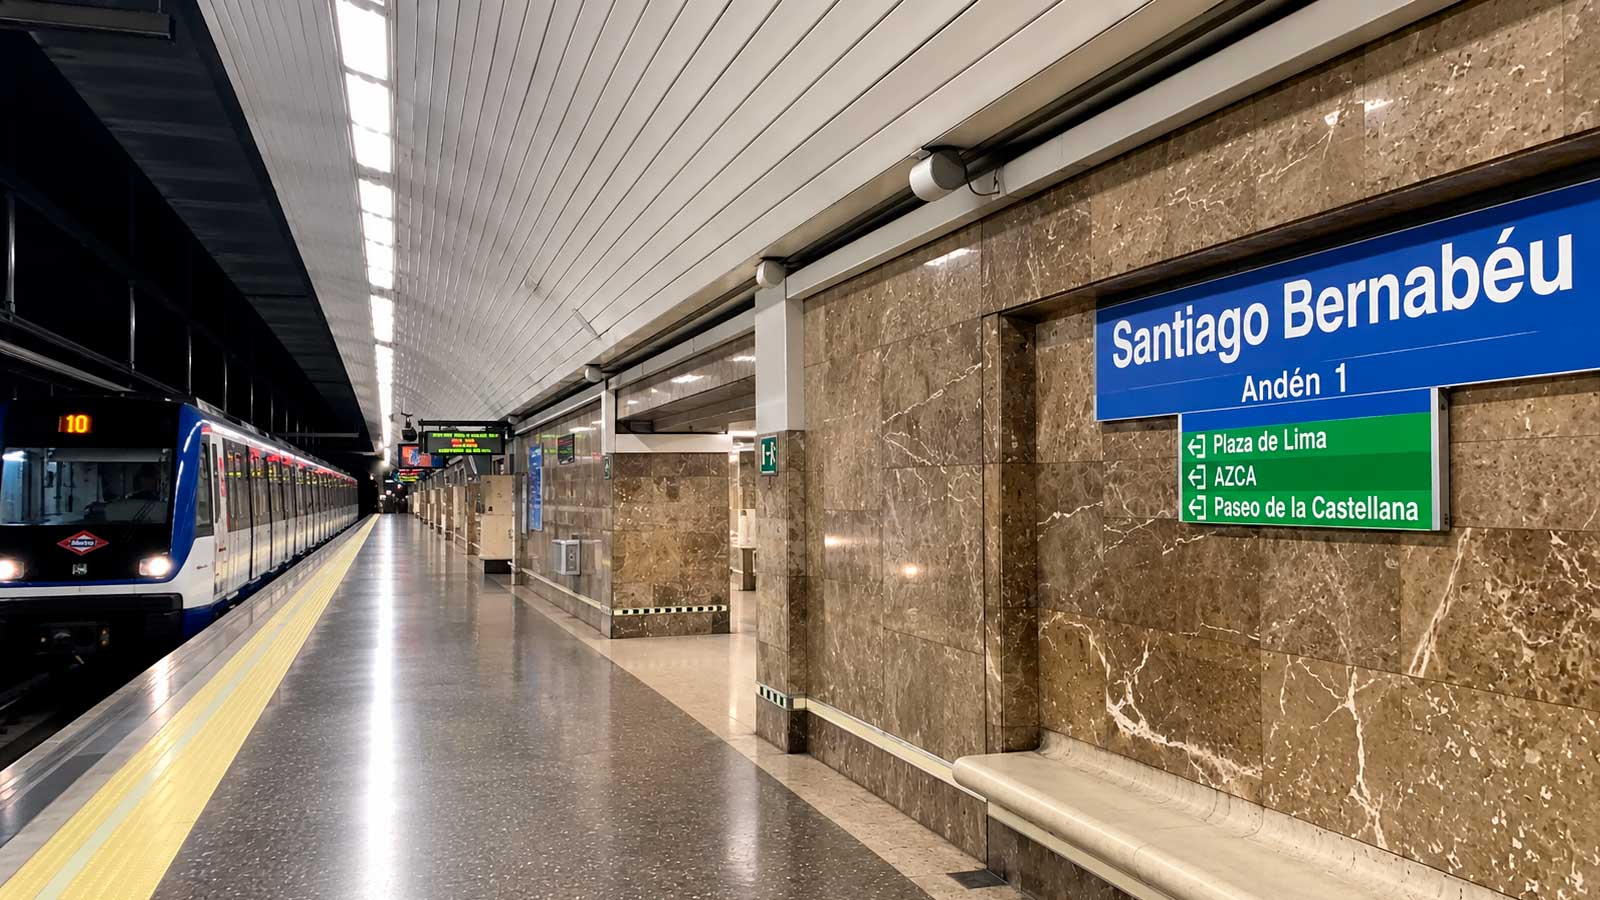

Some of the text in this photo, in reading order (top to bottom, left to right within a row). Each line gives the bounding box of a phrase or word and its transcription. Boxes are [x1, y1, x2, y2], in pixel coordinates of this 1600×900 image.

[1112, 226, 1574, 369] Santiago Bernabéu
[1241, 362, 1347, 403] Andén 1
[66, 414, 89, 434] 10
[1213, 427, 1327, 455] Plaza de Lima
[1214, 465, 1257, 487] AZCA
[1213, 495, 1419, 521] Paseo de la Castellana
